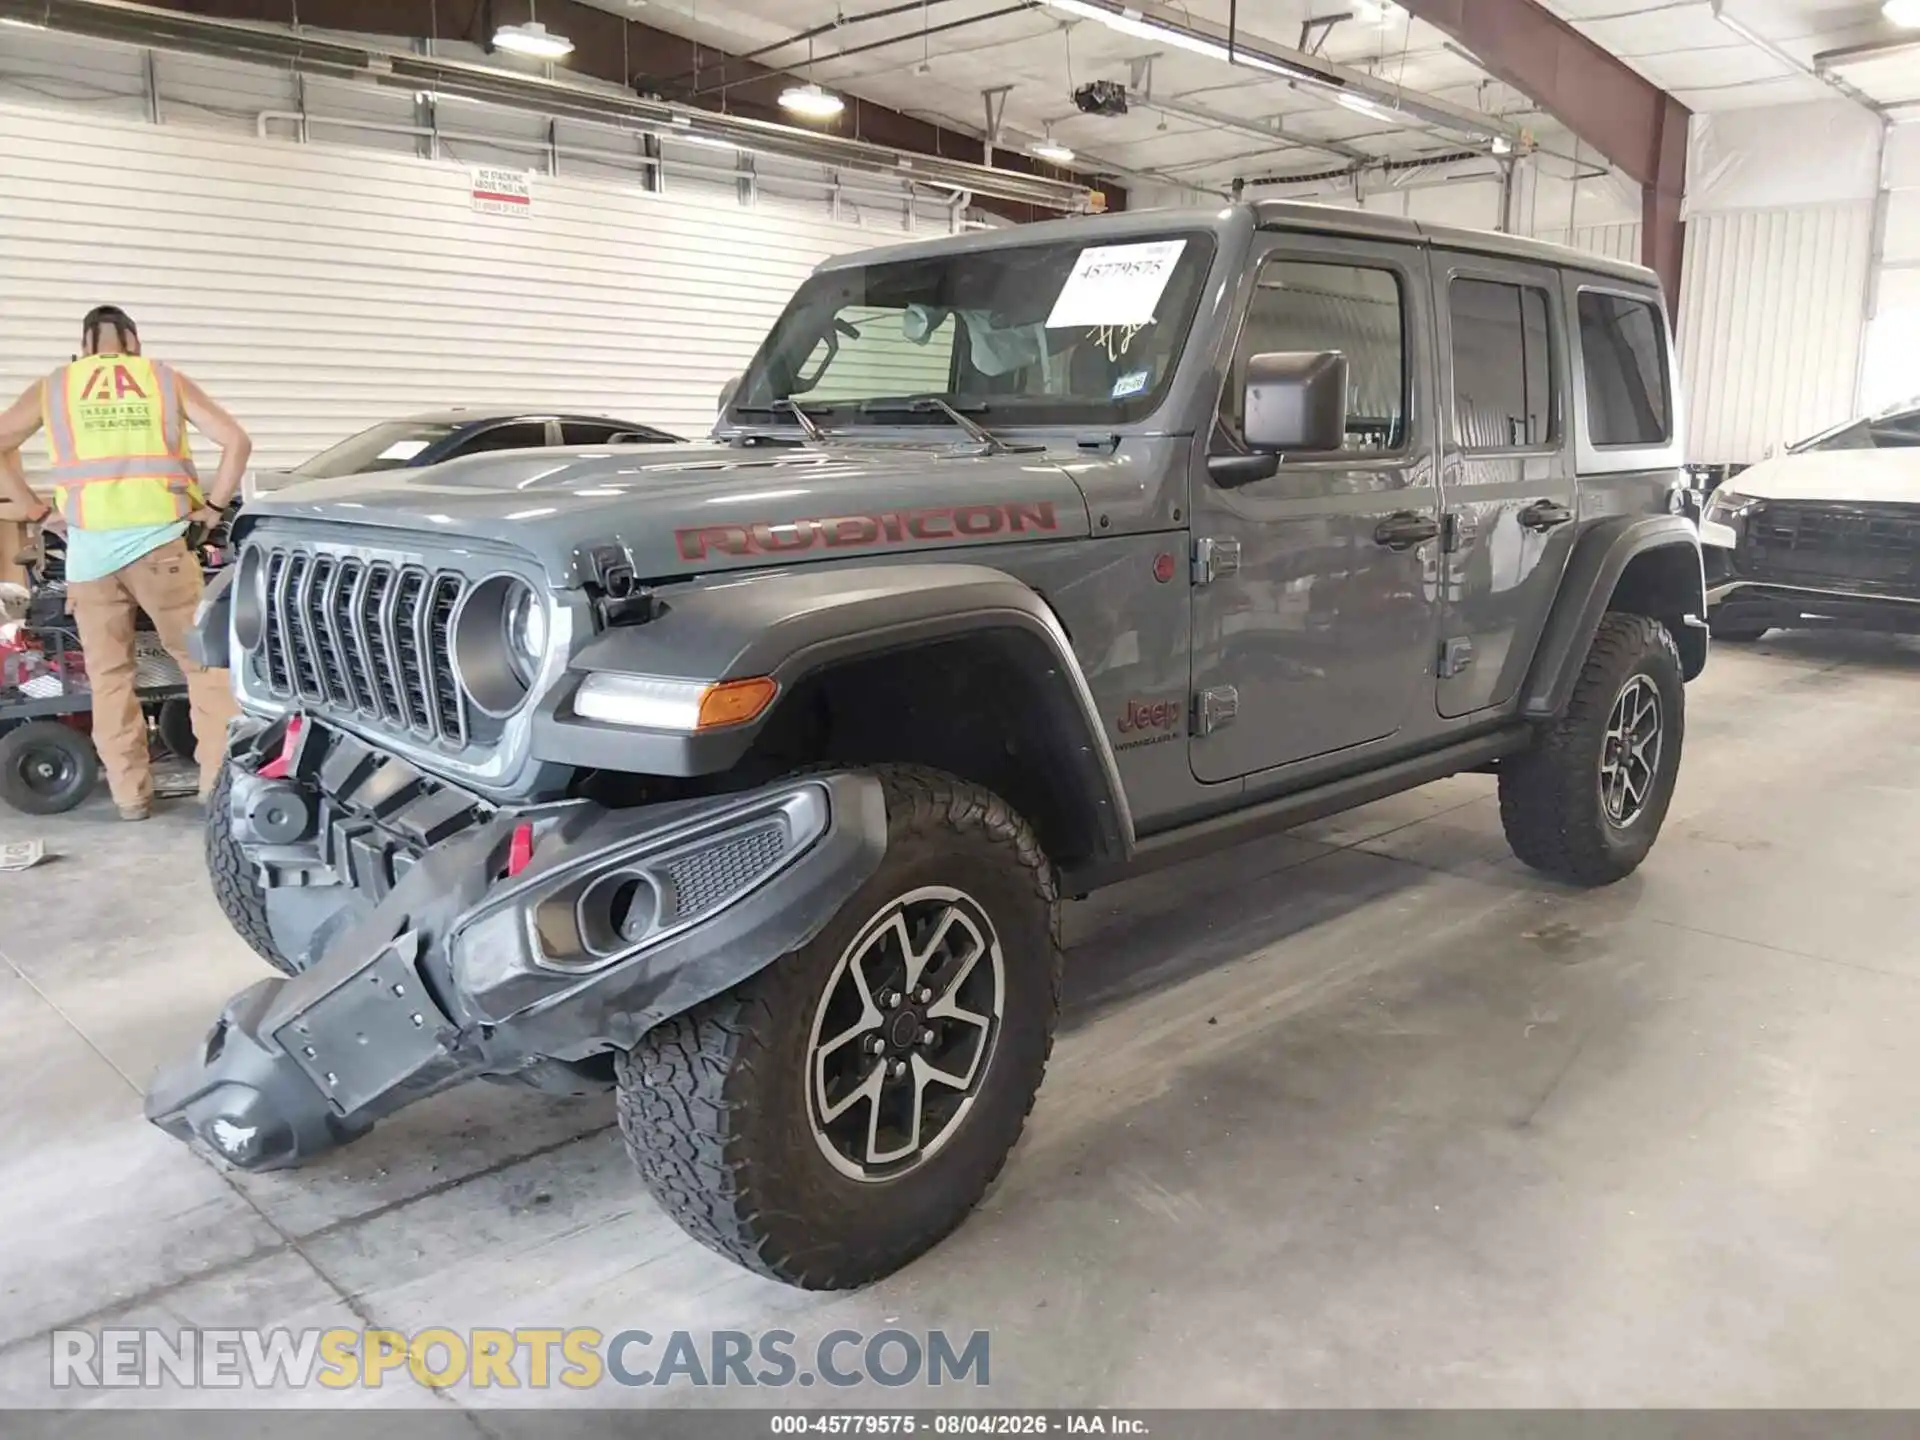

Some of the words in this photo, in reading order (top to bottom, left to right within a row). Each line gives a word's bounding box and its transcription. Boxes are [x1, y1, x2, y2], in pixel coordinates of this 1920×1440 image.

[479, 169, 489, 178] NO
[474, 179, 497, 191] ABOVE
[514, 184, 529, 196] LINE
[1080, 259, 1164, 279] 45779575
[79, 406, 149, 417] INSURANCE
[675, 500, 1058, 564] RUBICON
[1117, 700, 1179, 733] Jeep
